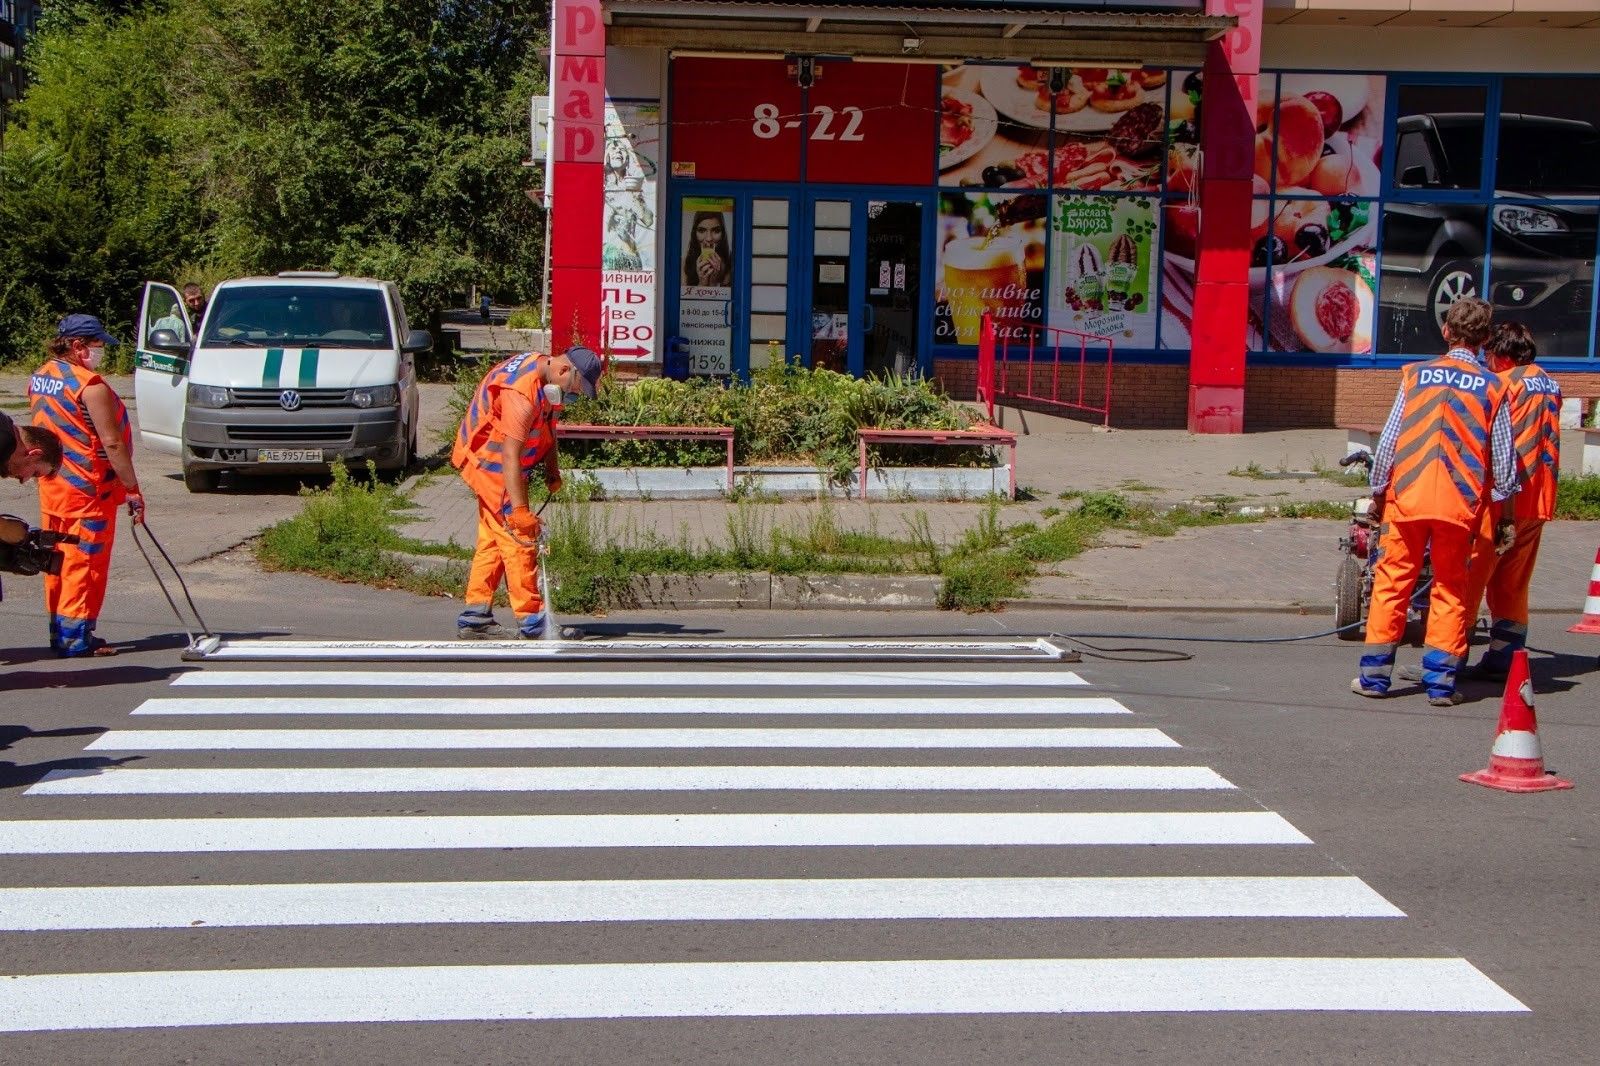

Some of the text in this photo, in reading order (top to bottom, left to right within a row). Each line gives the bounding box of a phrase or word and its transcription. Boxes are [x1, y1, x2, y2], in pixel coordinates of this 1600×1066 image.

[995, 302, 1042, 319] пиво
[688, 339, 726, 347] нижка
[1419, 368, 1486, 391] DSV-DP
